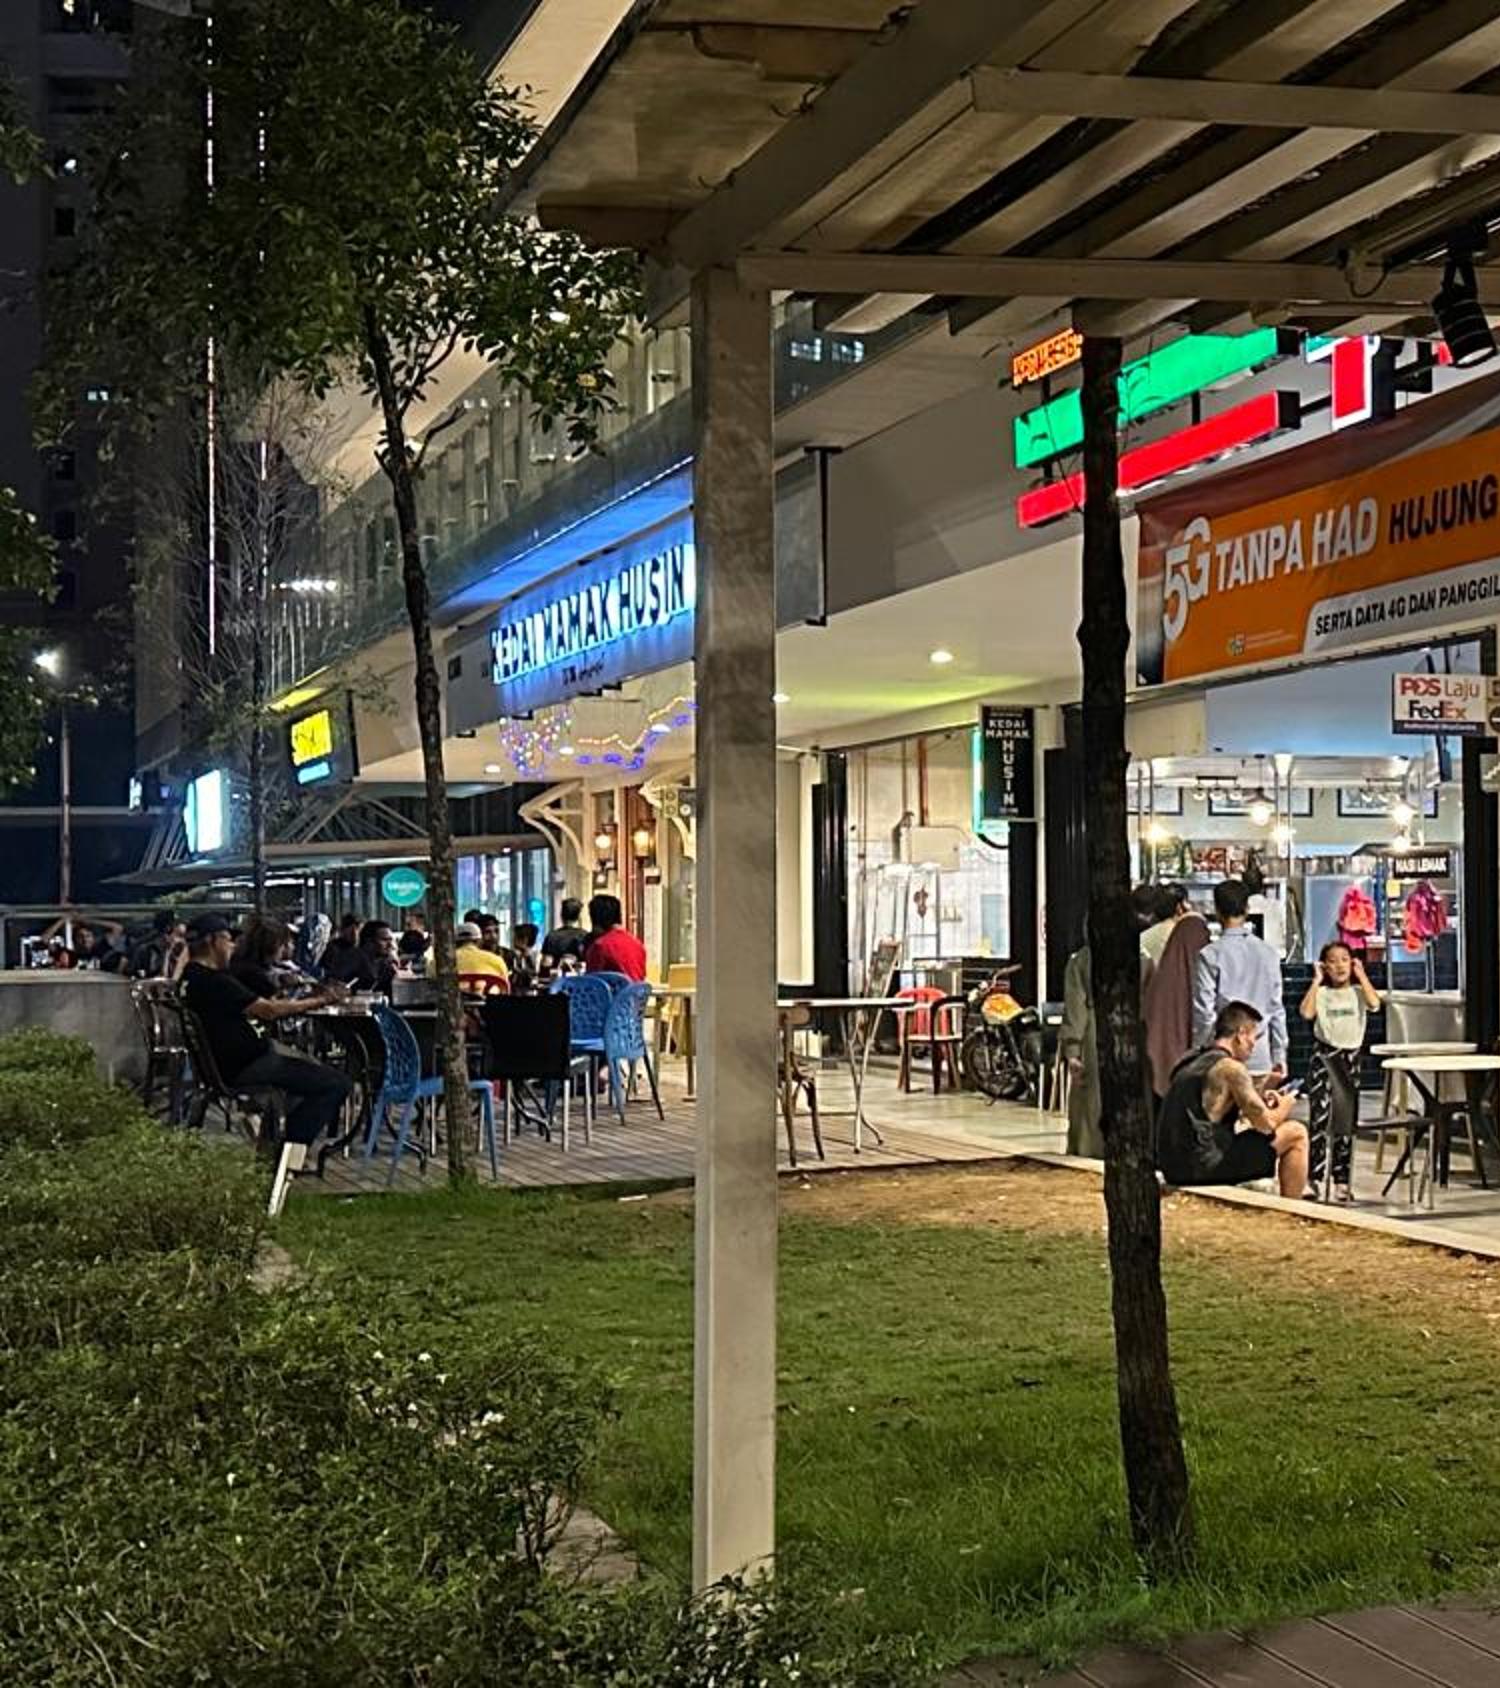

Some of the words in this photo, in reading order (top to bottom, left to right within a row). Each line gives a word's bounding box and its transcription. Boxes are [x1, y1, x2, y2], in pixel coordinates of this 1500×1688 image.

[1163, 516, 1211, 642] 5G
[1215, 519, 1304, 592] TANPA
[1311, 497, 1378, 567] HAD
[1388, 473, 1499, 544] HUJUNG
[617, 545, 686, 634] HUSIN
[1315, 608, 1353, 637] SERTA
[1355, 601, 1387, 628] DATA
[1388, 598, 1406, 621] 4G
[1408, 590, 1437, 617] DAN
[1400, 677, 1441, 697] POS
[1444, 678, 1480, 701] Laju
[988, 719, 1026, 729] KEDAI
[1408, 700, 1467, 720] FedEx
[985, 729, 1030, 739] MAMAK
[1002, 740, 1015, 806] HUSIN
